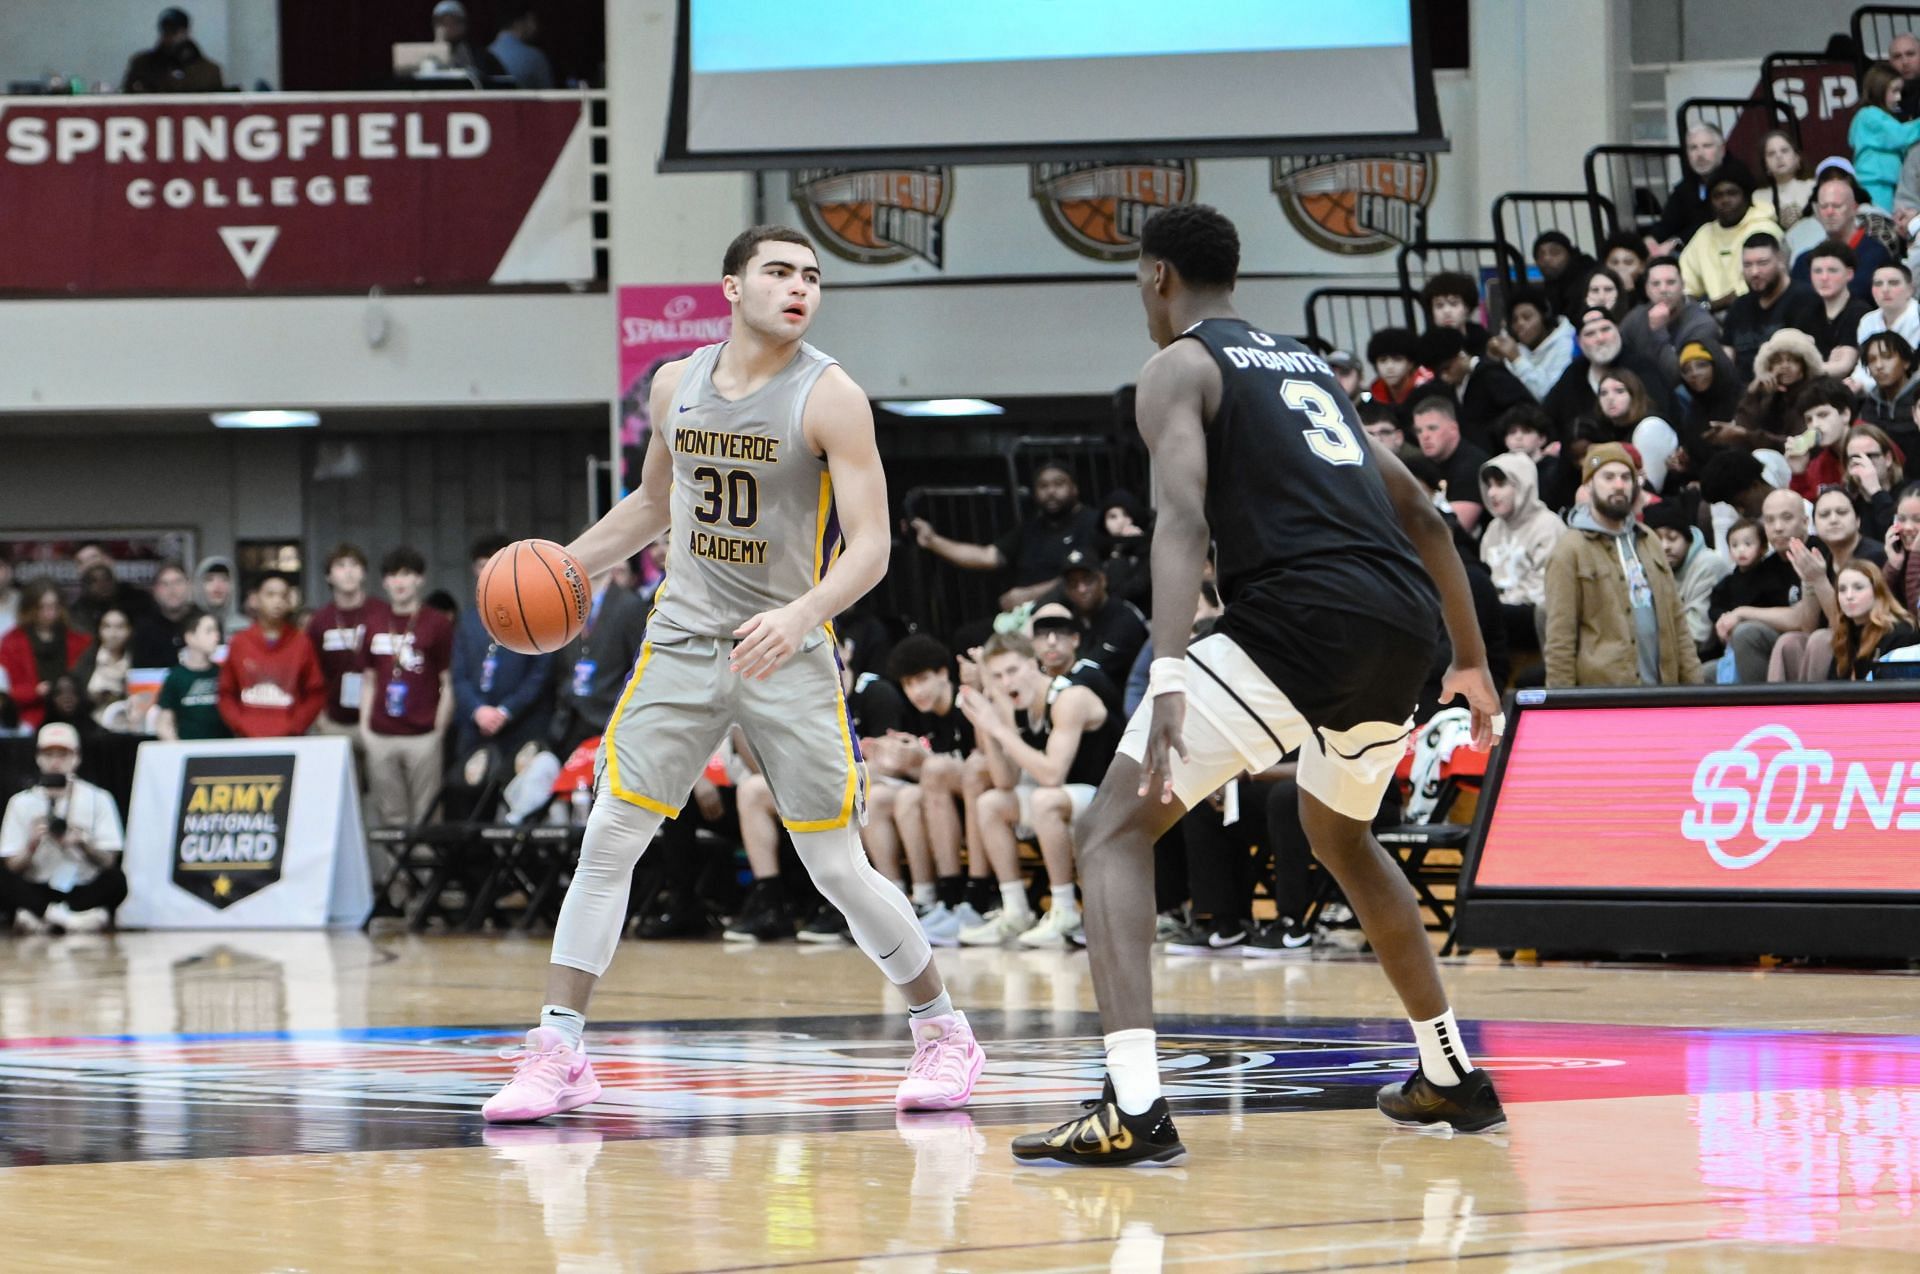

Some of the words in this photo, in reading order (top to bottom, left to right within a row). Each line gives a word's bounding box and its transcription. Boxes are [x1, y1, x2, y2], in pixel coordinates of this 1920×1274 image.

[1772, 76, 1860, 122] SP
[6, 112, 491, 164] SPRINGFIELD
[126, 176, 372, 208] COLLEGE
[1280, 379, 1364, 466] 3
[674, 427, 780, 463] MONTVERDE
[693, 466, 759, 529] 30
[689, 530, 768, 565] ACADEMY
[187, 783, 282, 813] ARMY
[183, 813, 278, 833] NATIONAL
[179, 832, 278, 863] GUARD
